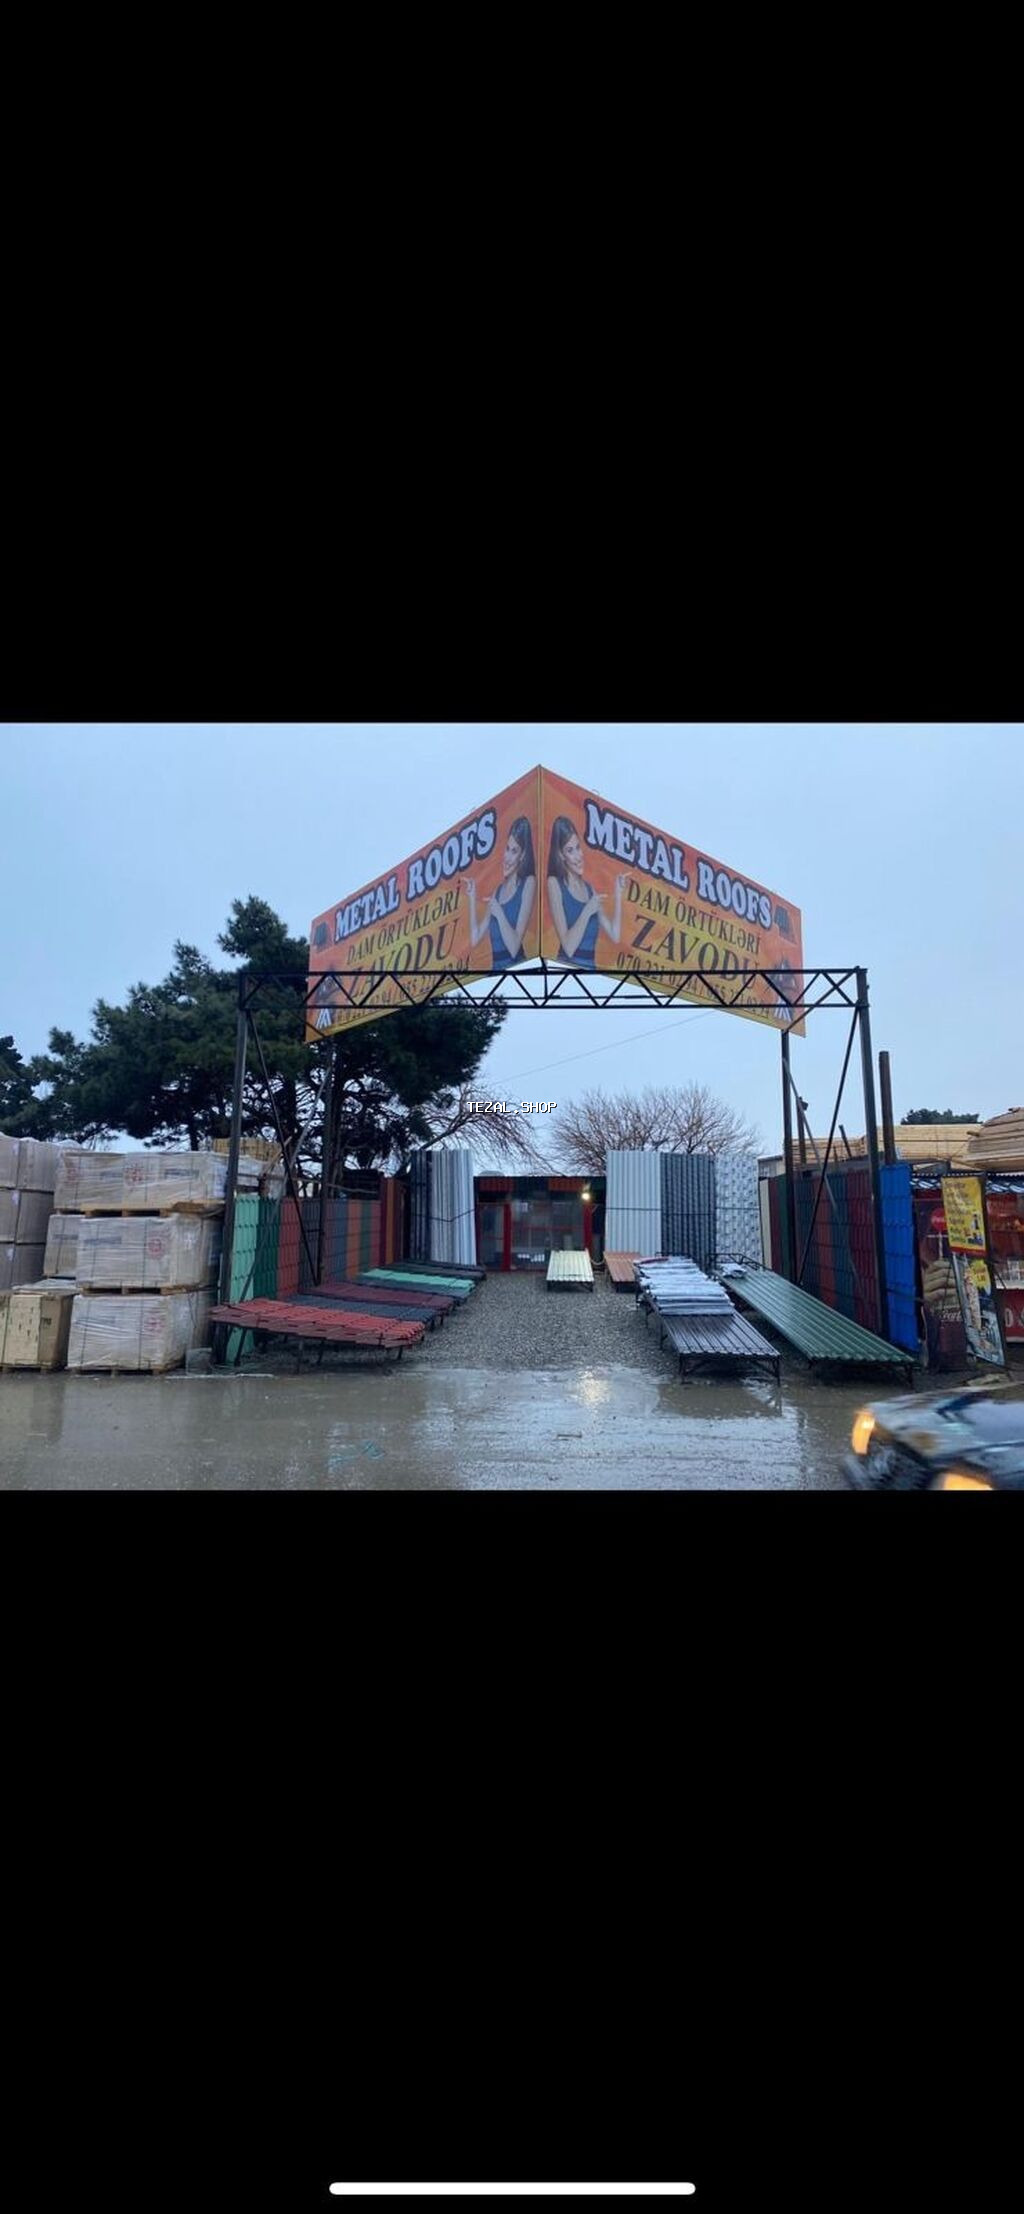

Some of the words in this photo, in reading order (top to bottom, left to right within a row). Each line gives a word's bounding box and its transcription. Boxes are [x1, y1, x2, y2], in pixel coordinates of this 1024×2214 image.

[334, 873, 400, 943] METAL
[407, 808, 496, 902] ROOFS
[585, 800, 689, 890] METAL
[696, 858, 772, 929] ROOFS
[347, 934, 374, 965] DAM
[627, 879, 670, 916] DAM
[675, 896, 762, 955] ÖRTÜKLƏRİ
[631, 914, 760, 990] ZAVODU
[616, 951, 641, 976] 070
